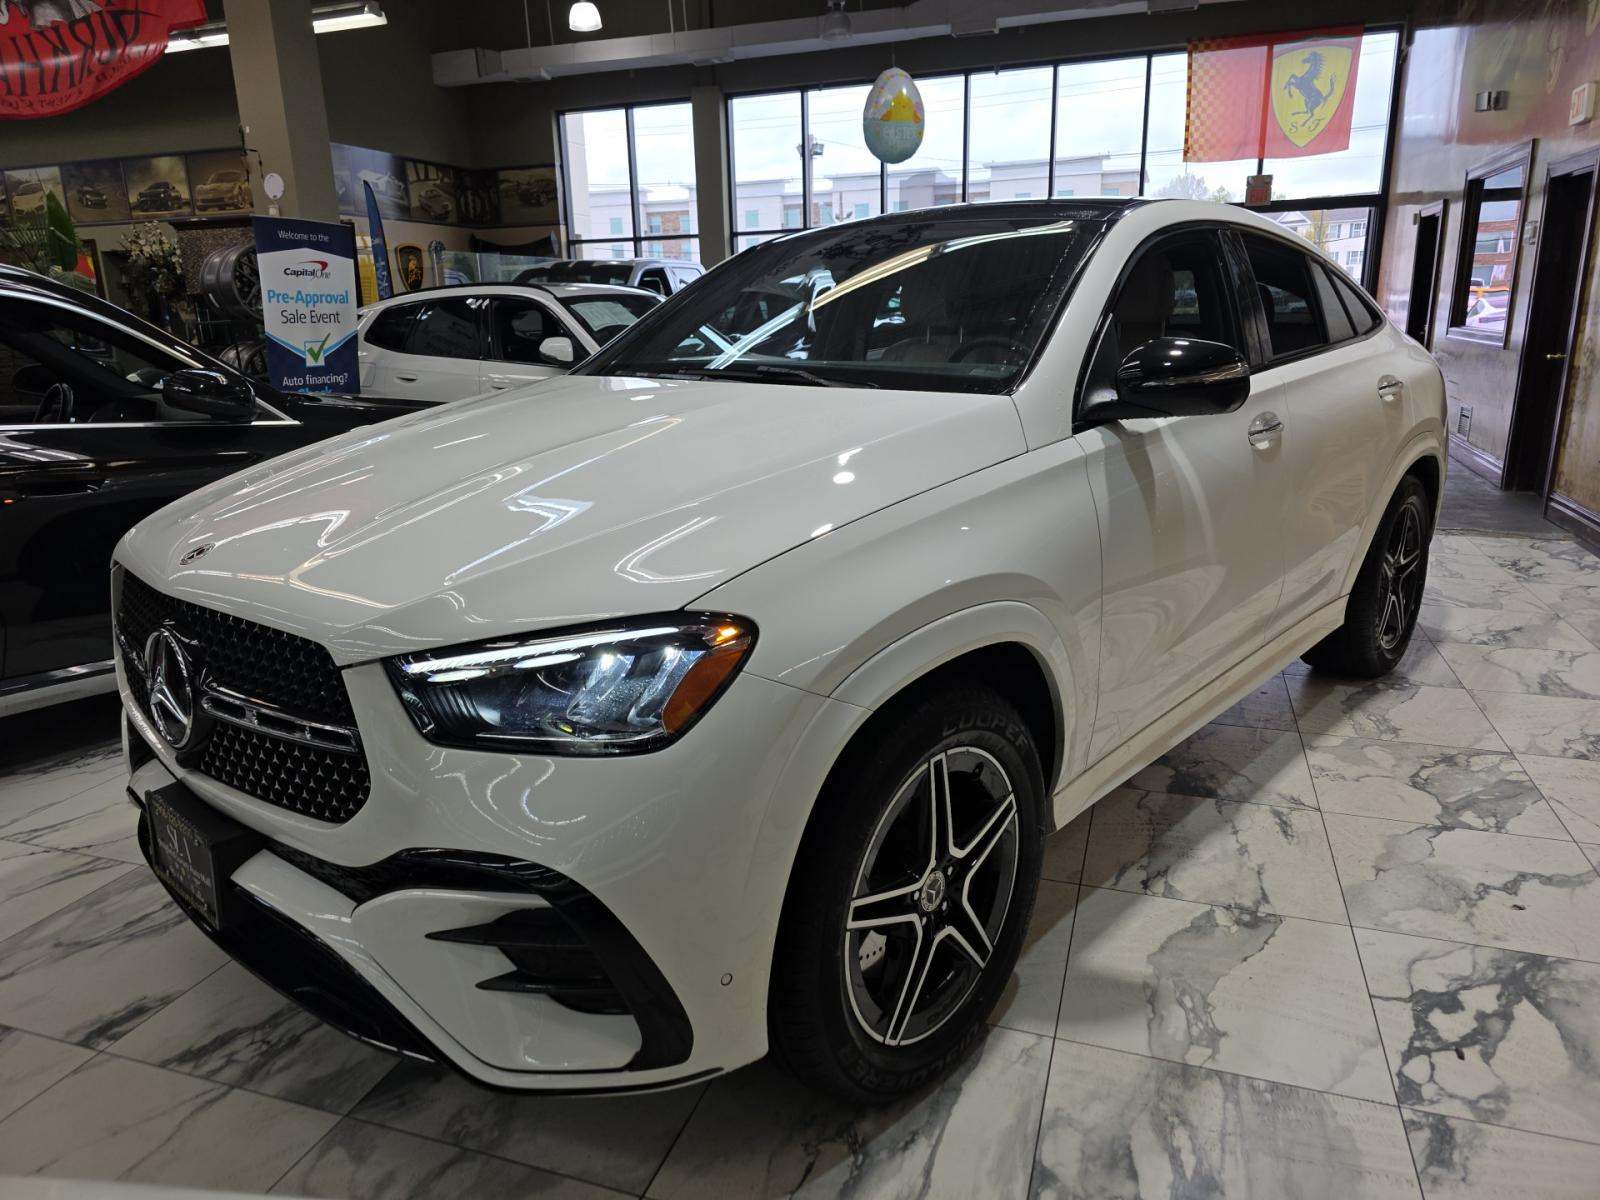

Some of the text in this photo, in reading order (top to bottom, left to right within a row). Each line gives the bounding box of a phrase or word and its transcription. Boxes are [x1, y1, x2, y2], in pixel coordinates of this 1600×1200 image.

[277, 229, 329, 242] Welcome to the
[267, 289, 349, 308] Pre-Approval
[280, 309, 341, 324] Sale Event
[282, 372, 349, 387] Auto financing?
